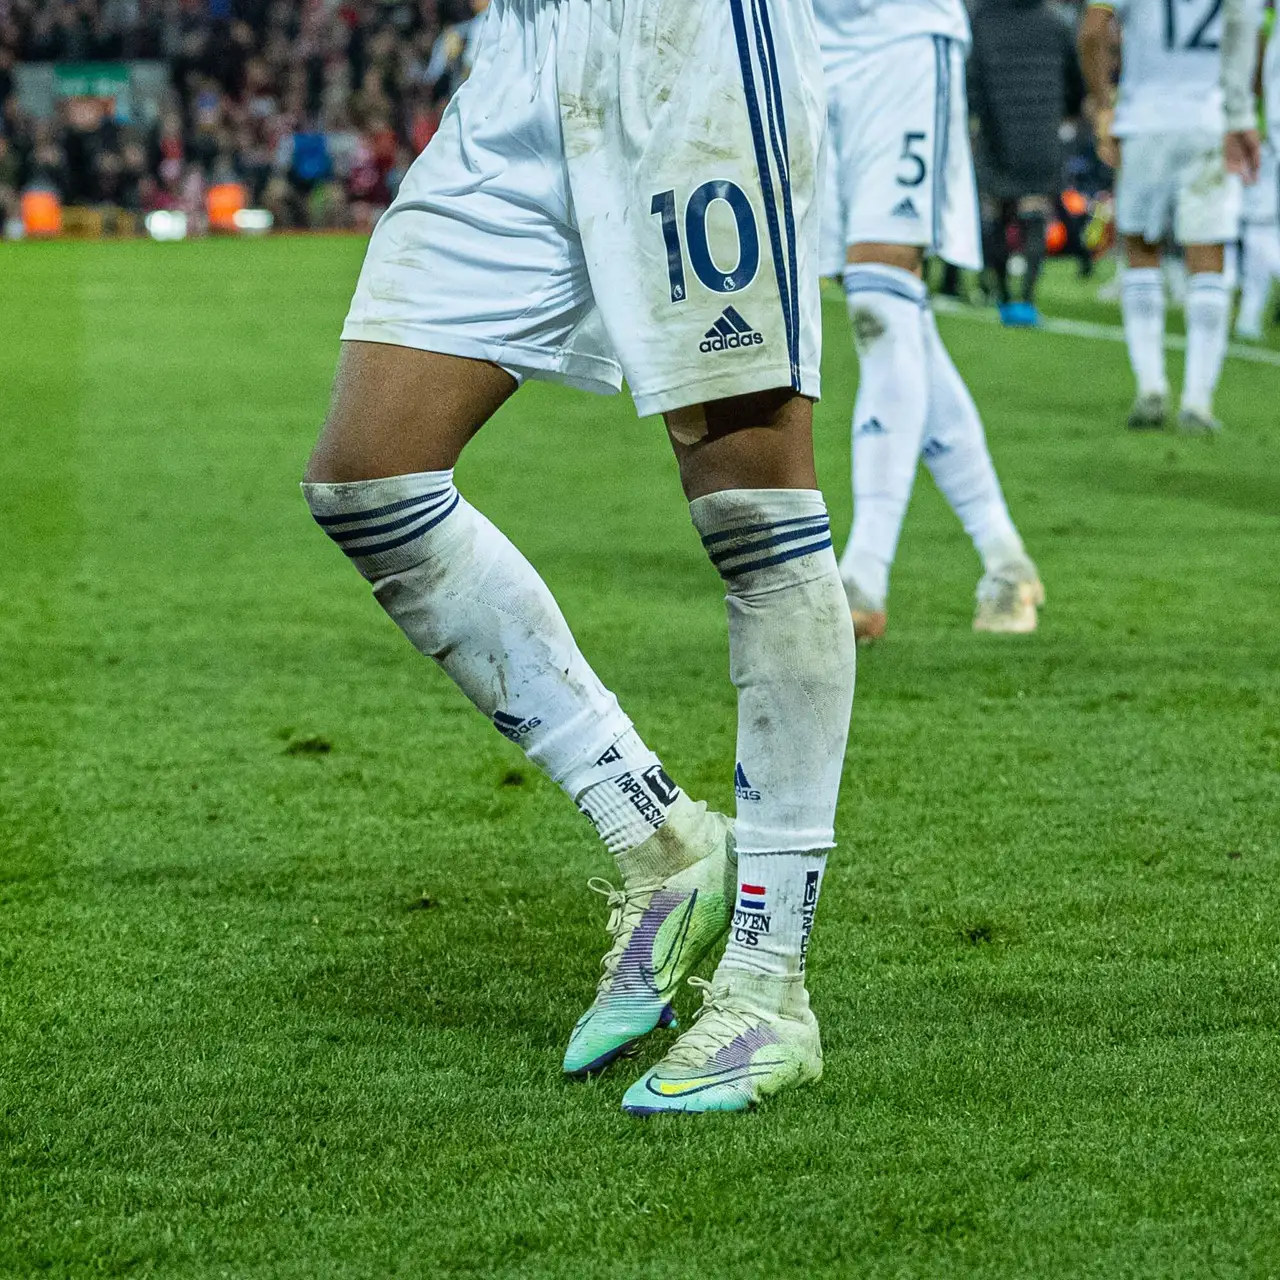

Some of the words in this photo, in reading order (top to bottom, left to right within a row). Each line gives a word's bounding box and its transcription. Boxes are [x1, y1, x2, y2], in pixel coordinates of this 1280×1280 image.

[895, 131, 926, 188] 5
[650, 177, 761, 303] 10
[699, 331, 764, 353] adidas
